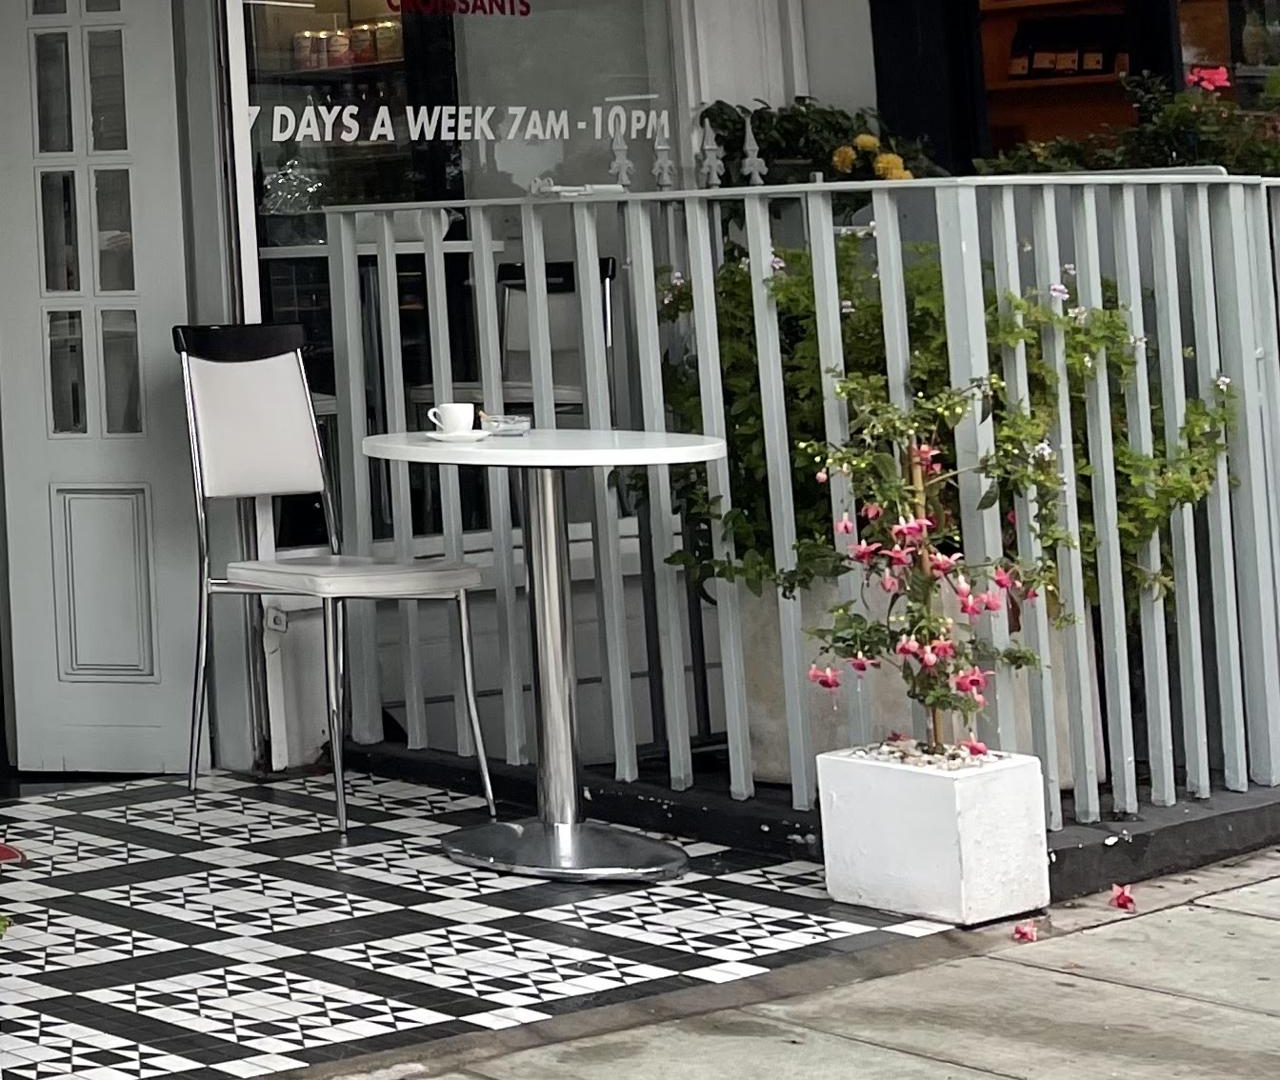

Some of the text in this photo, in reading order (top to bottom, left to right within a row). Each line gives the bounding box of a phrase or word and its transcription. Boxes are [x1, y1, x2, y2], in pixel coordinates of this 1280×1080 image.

[272, 105, 360, 142] DAYS
[369, 106, 395, 141] A
[405, 105, 498, 142] WEEK
